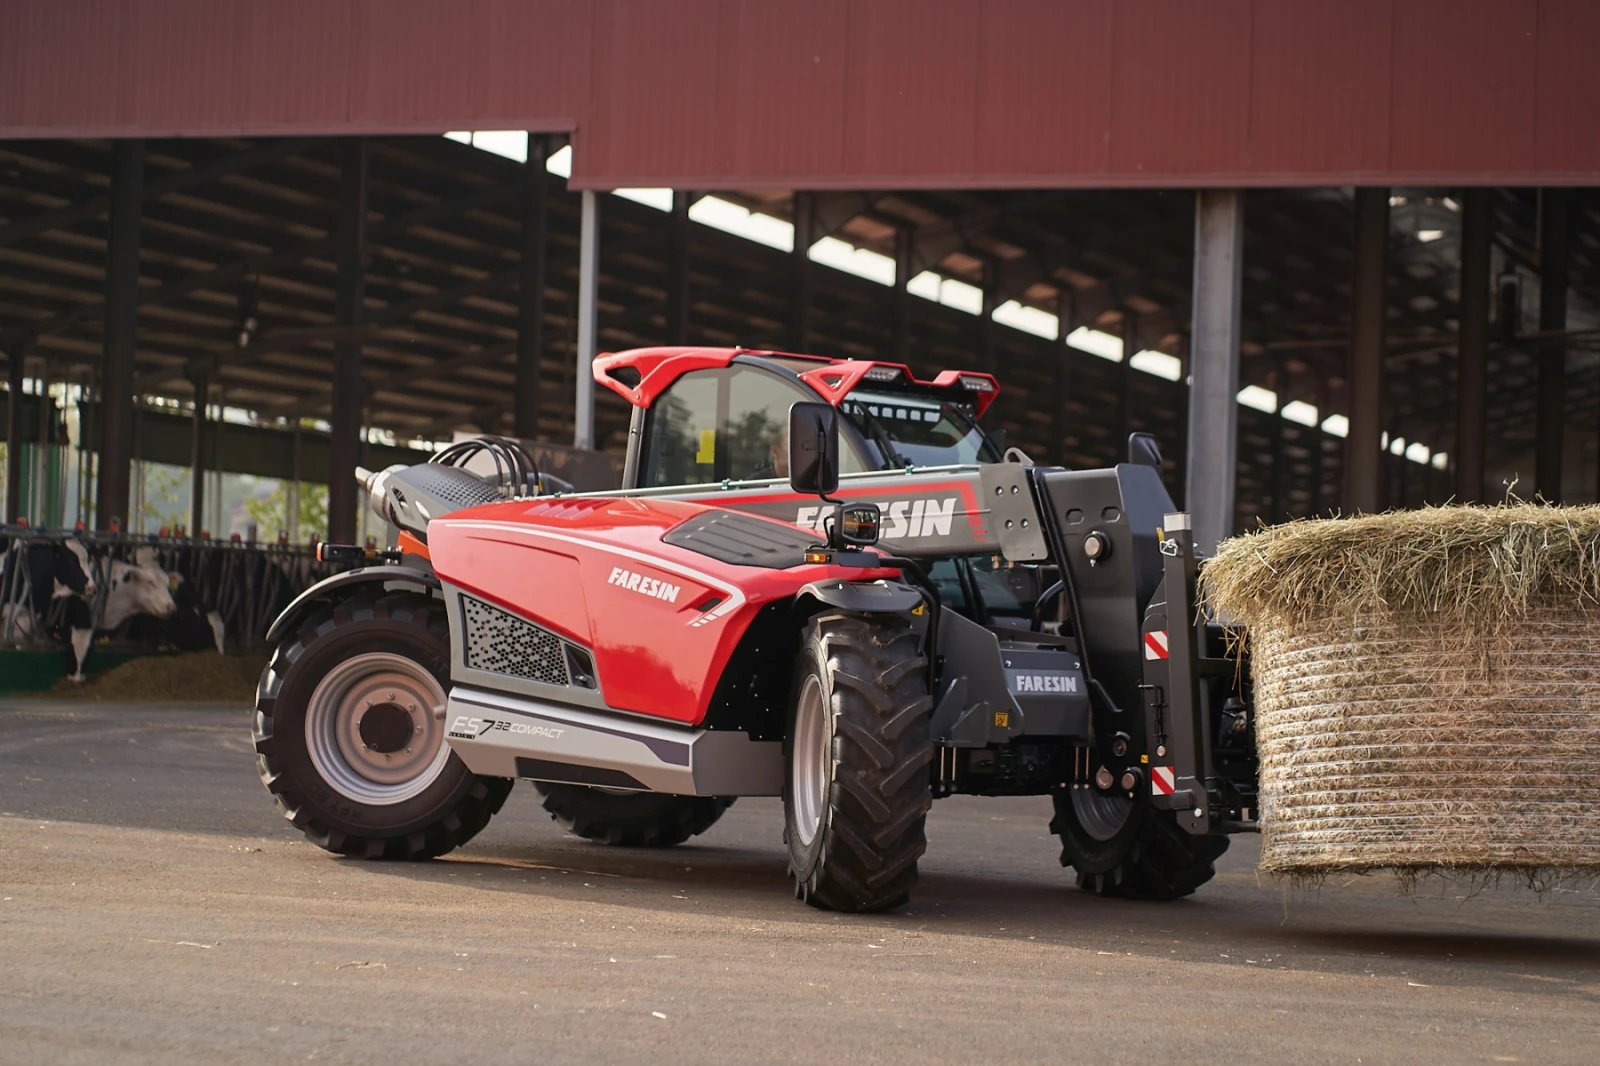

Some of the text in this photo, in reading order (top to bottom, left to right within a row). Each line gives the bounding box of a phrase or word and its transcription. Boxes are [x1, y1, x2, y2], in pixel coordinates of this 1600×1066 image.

[796, 498, 957, 541] FASIN
[607, 566, 681, 604] FARESIN
[1016, 675, 1077, 693] FARESIN
[510, 722, 565, 740] COMPACT
